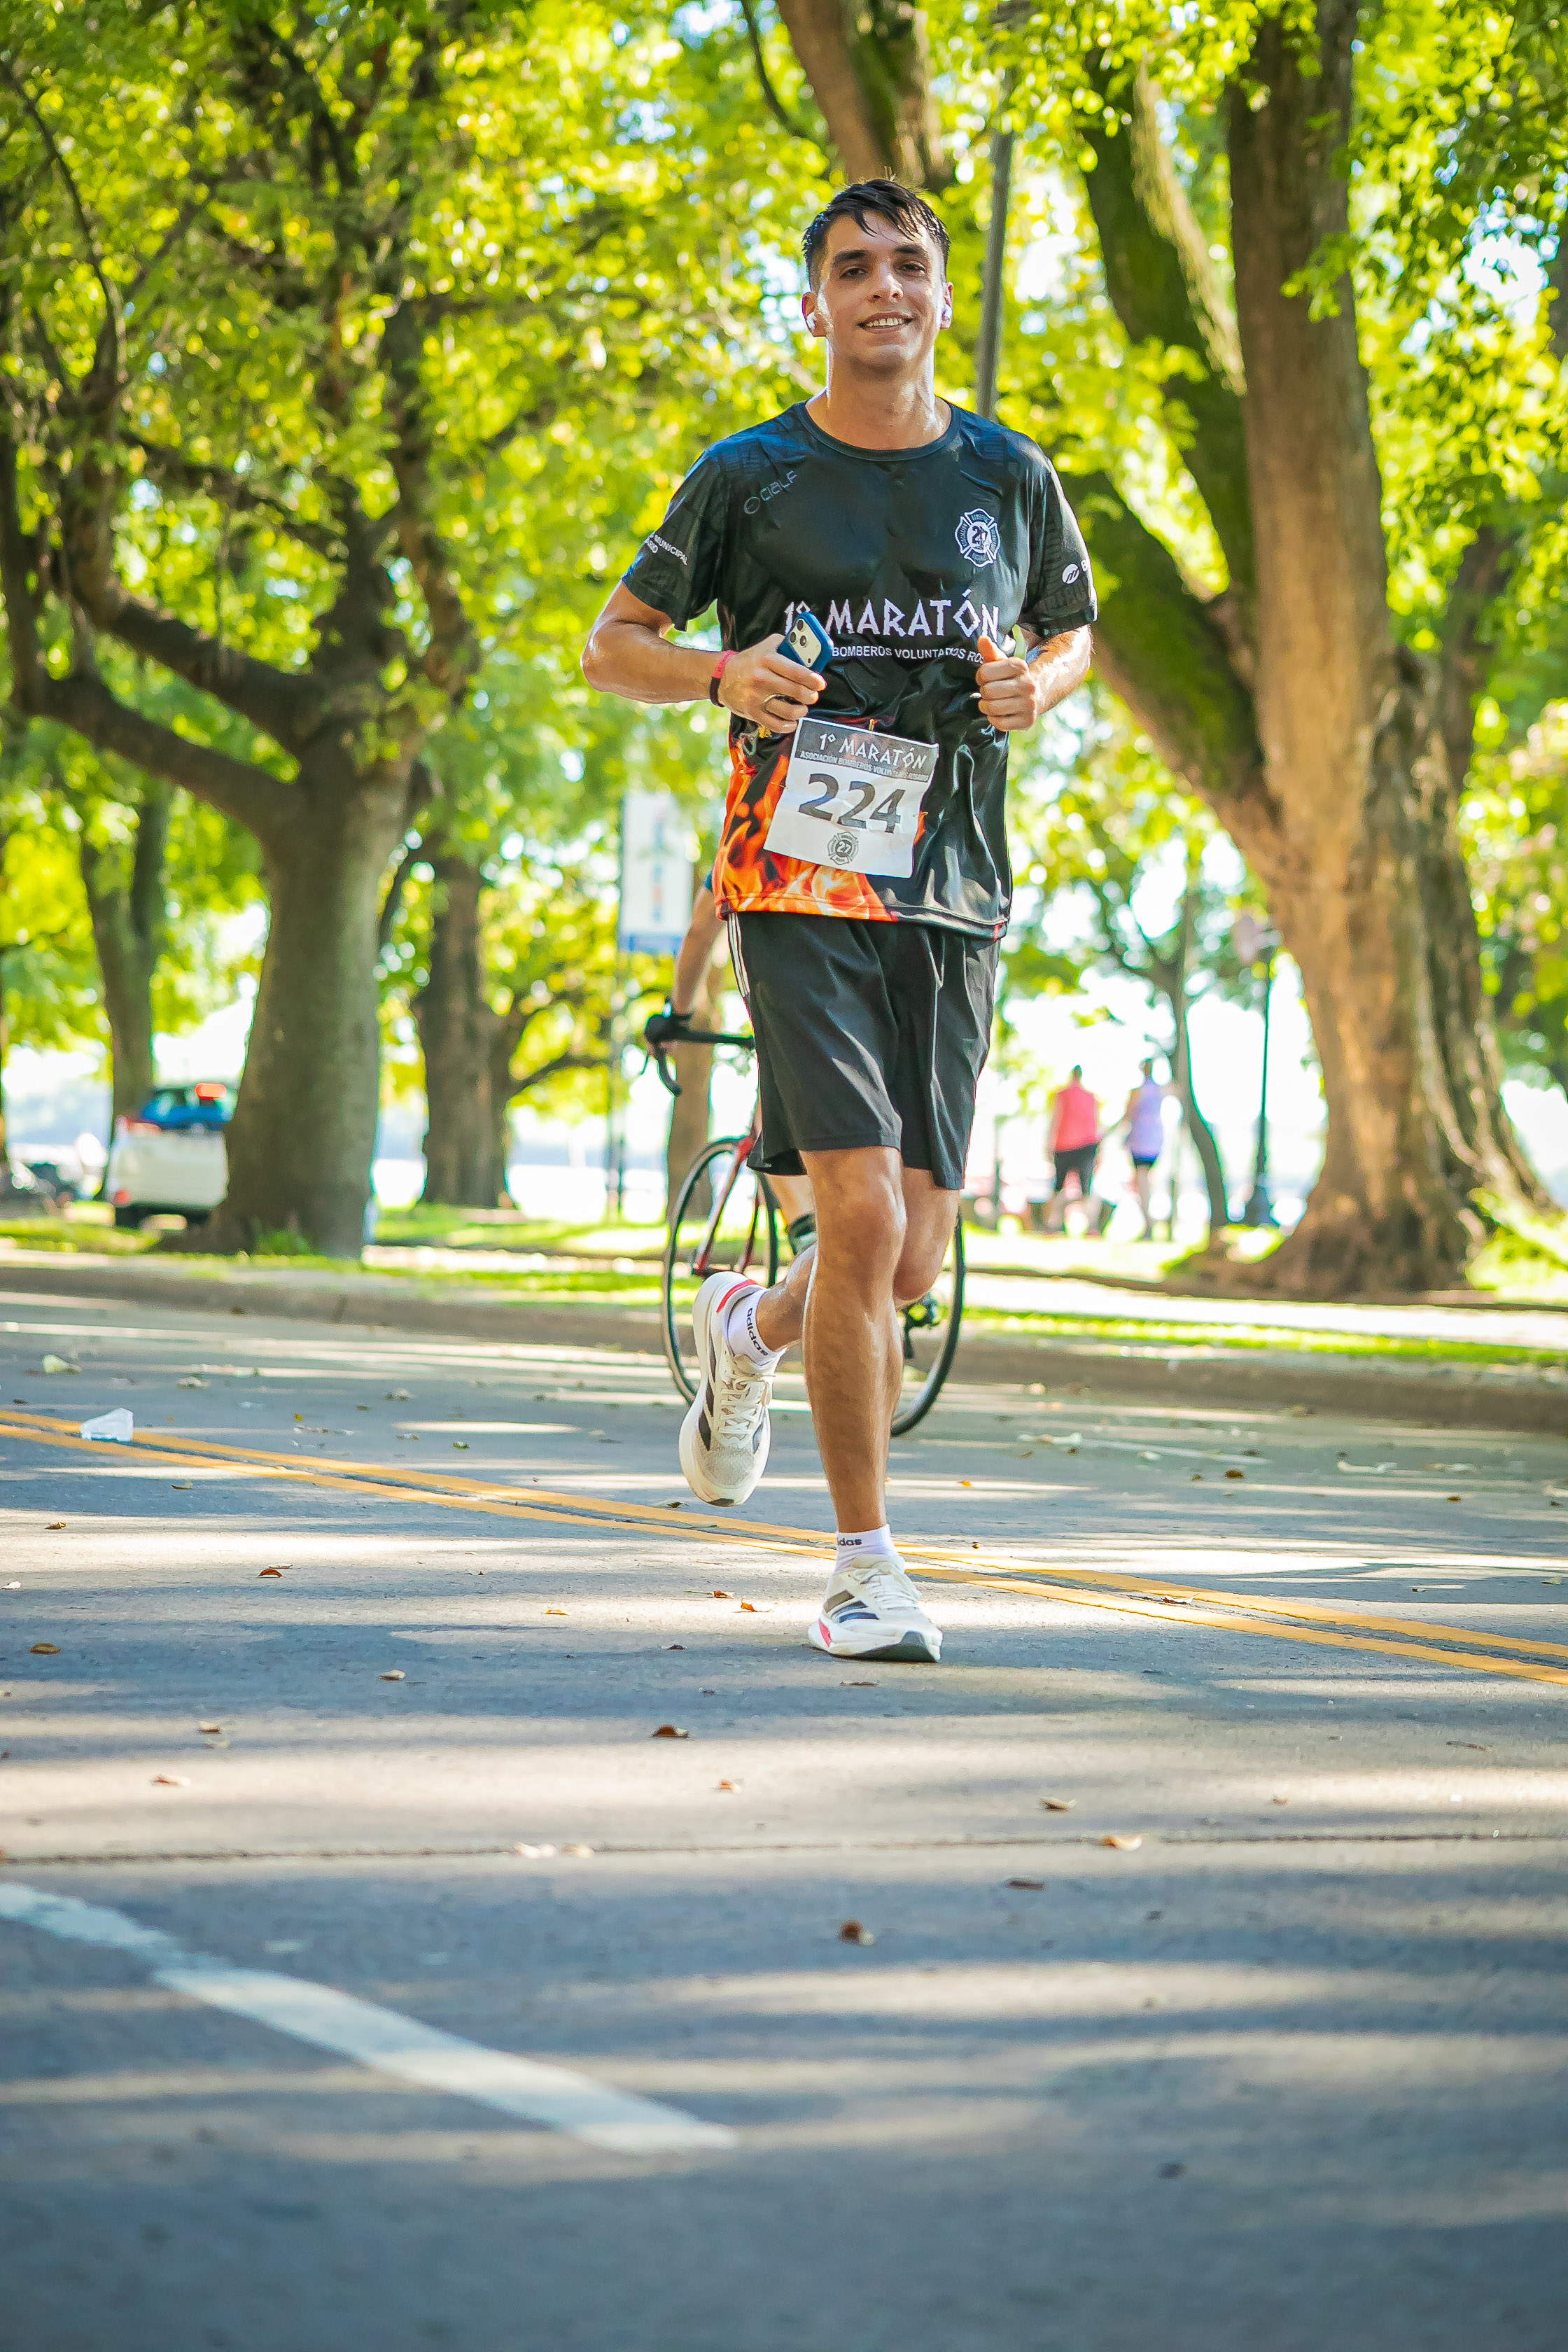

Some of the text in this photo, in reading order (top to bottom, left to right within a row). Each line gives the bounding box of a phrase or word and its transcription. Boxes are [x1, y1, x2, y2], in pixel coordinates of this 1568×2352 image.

[825, 588, 1000, 643] MARATÓN
[832, 645, 892, 657] BOMBEROS
[839, 736, 927, 769] MARATÓN
[798, 774, 906, 834] 224
[836, 841, 852, 854] 27
[746, 1308, 769, 1357] adidas
